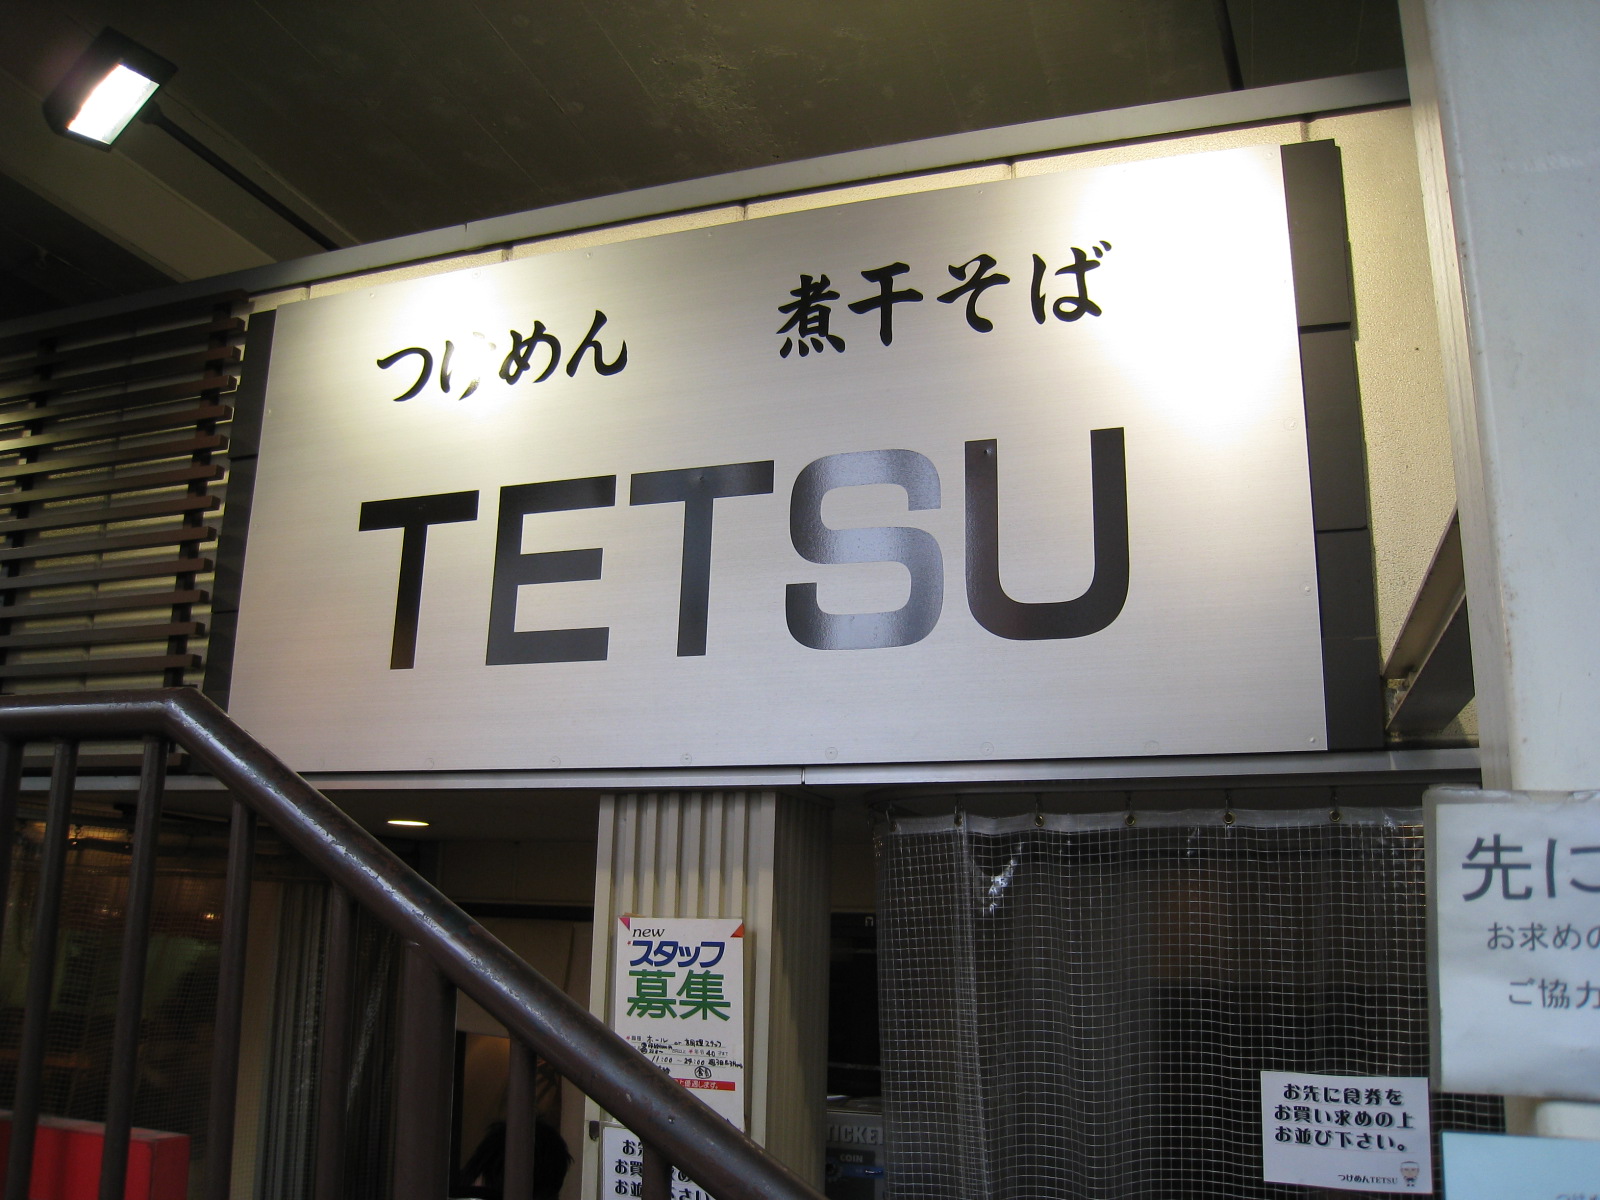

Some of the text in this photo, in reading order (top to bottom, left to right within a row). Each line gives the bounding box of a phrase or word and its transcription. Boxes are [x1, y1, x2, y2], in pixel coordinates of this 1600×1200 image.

[776, 240, 1112, 358] 煮干そば
[358, 426, 1130, 671] TETSU
[1462, 833, 1600, 902] 先に
[631, 927, 666, 938] new
[629, 940, 726, 968] スタッフ
[626, 968, 732, 1022] 募集
[1508, 976, 1600, 1009] ご協力
[1283, 1083, 1405, 1106] お先に食券を
[1274, 1104, 1416, 1130] お買い求めの上
